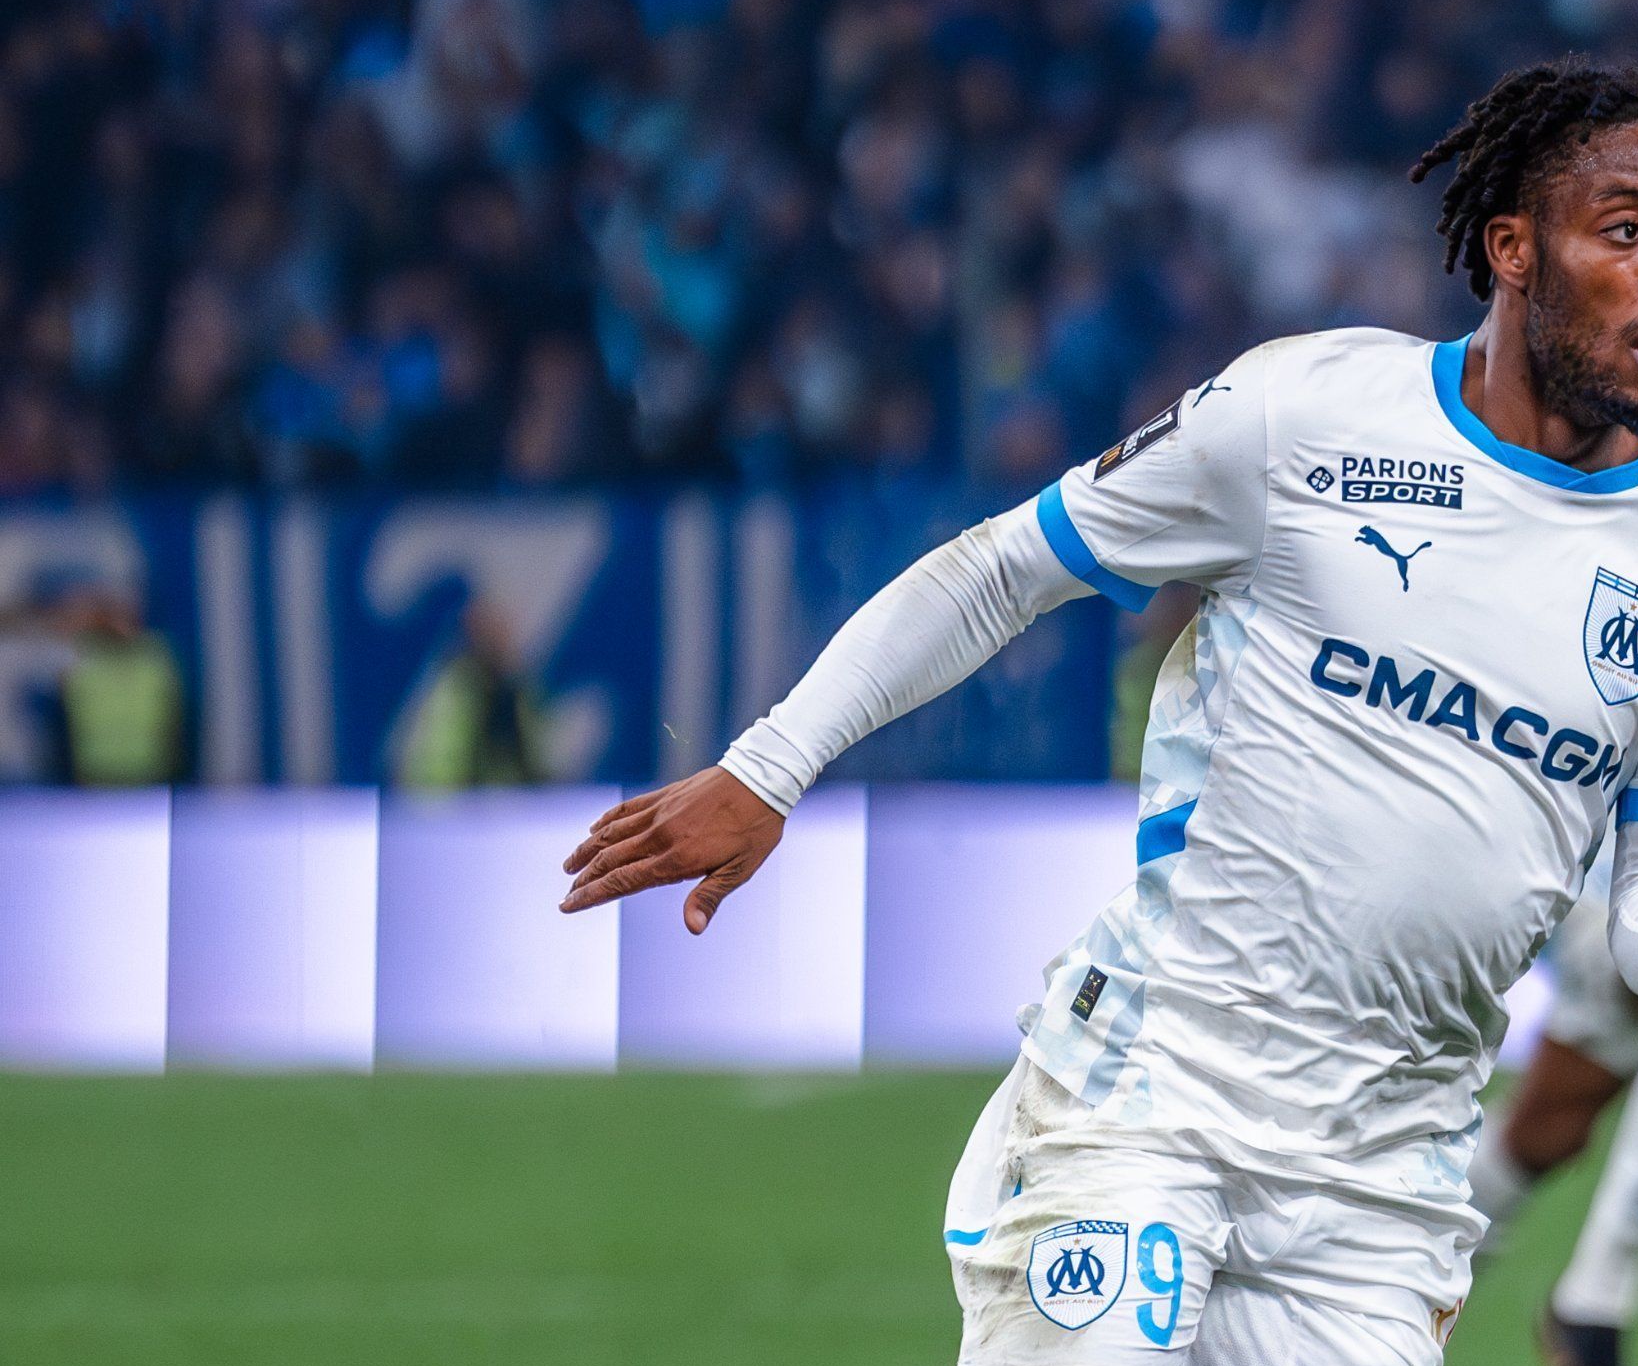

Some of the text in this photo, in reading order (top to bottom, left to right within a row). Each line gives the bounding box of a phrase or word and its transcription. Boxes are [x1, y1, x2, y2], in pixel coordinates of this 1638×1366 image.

[1341, 456, 1465, 485] PARIONS
[1346, 483, 1459, 506] SPORT
[1136, 1221, 1184, 1348] 9
